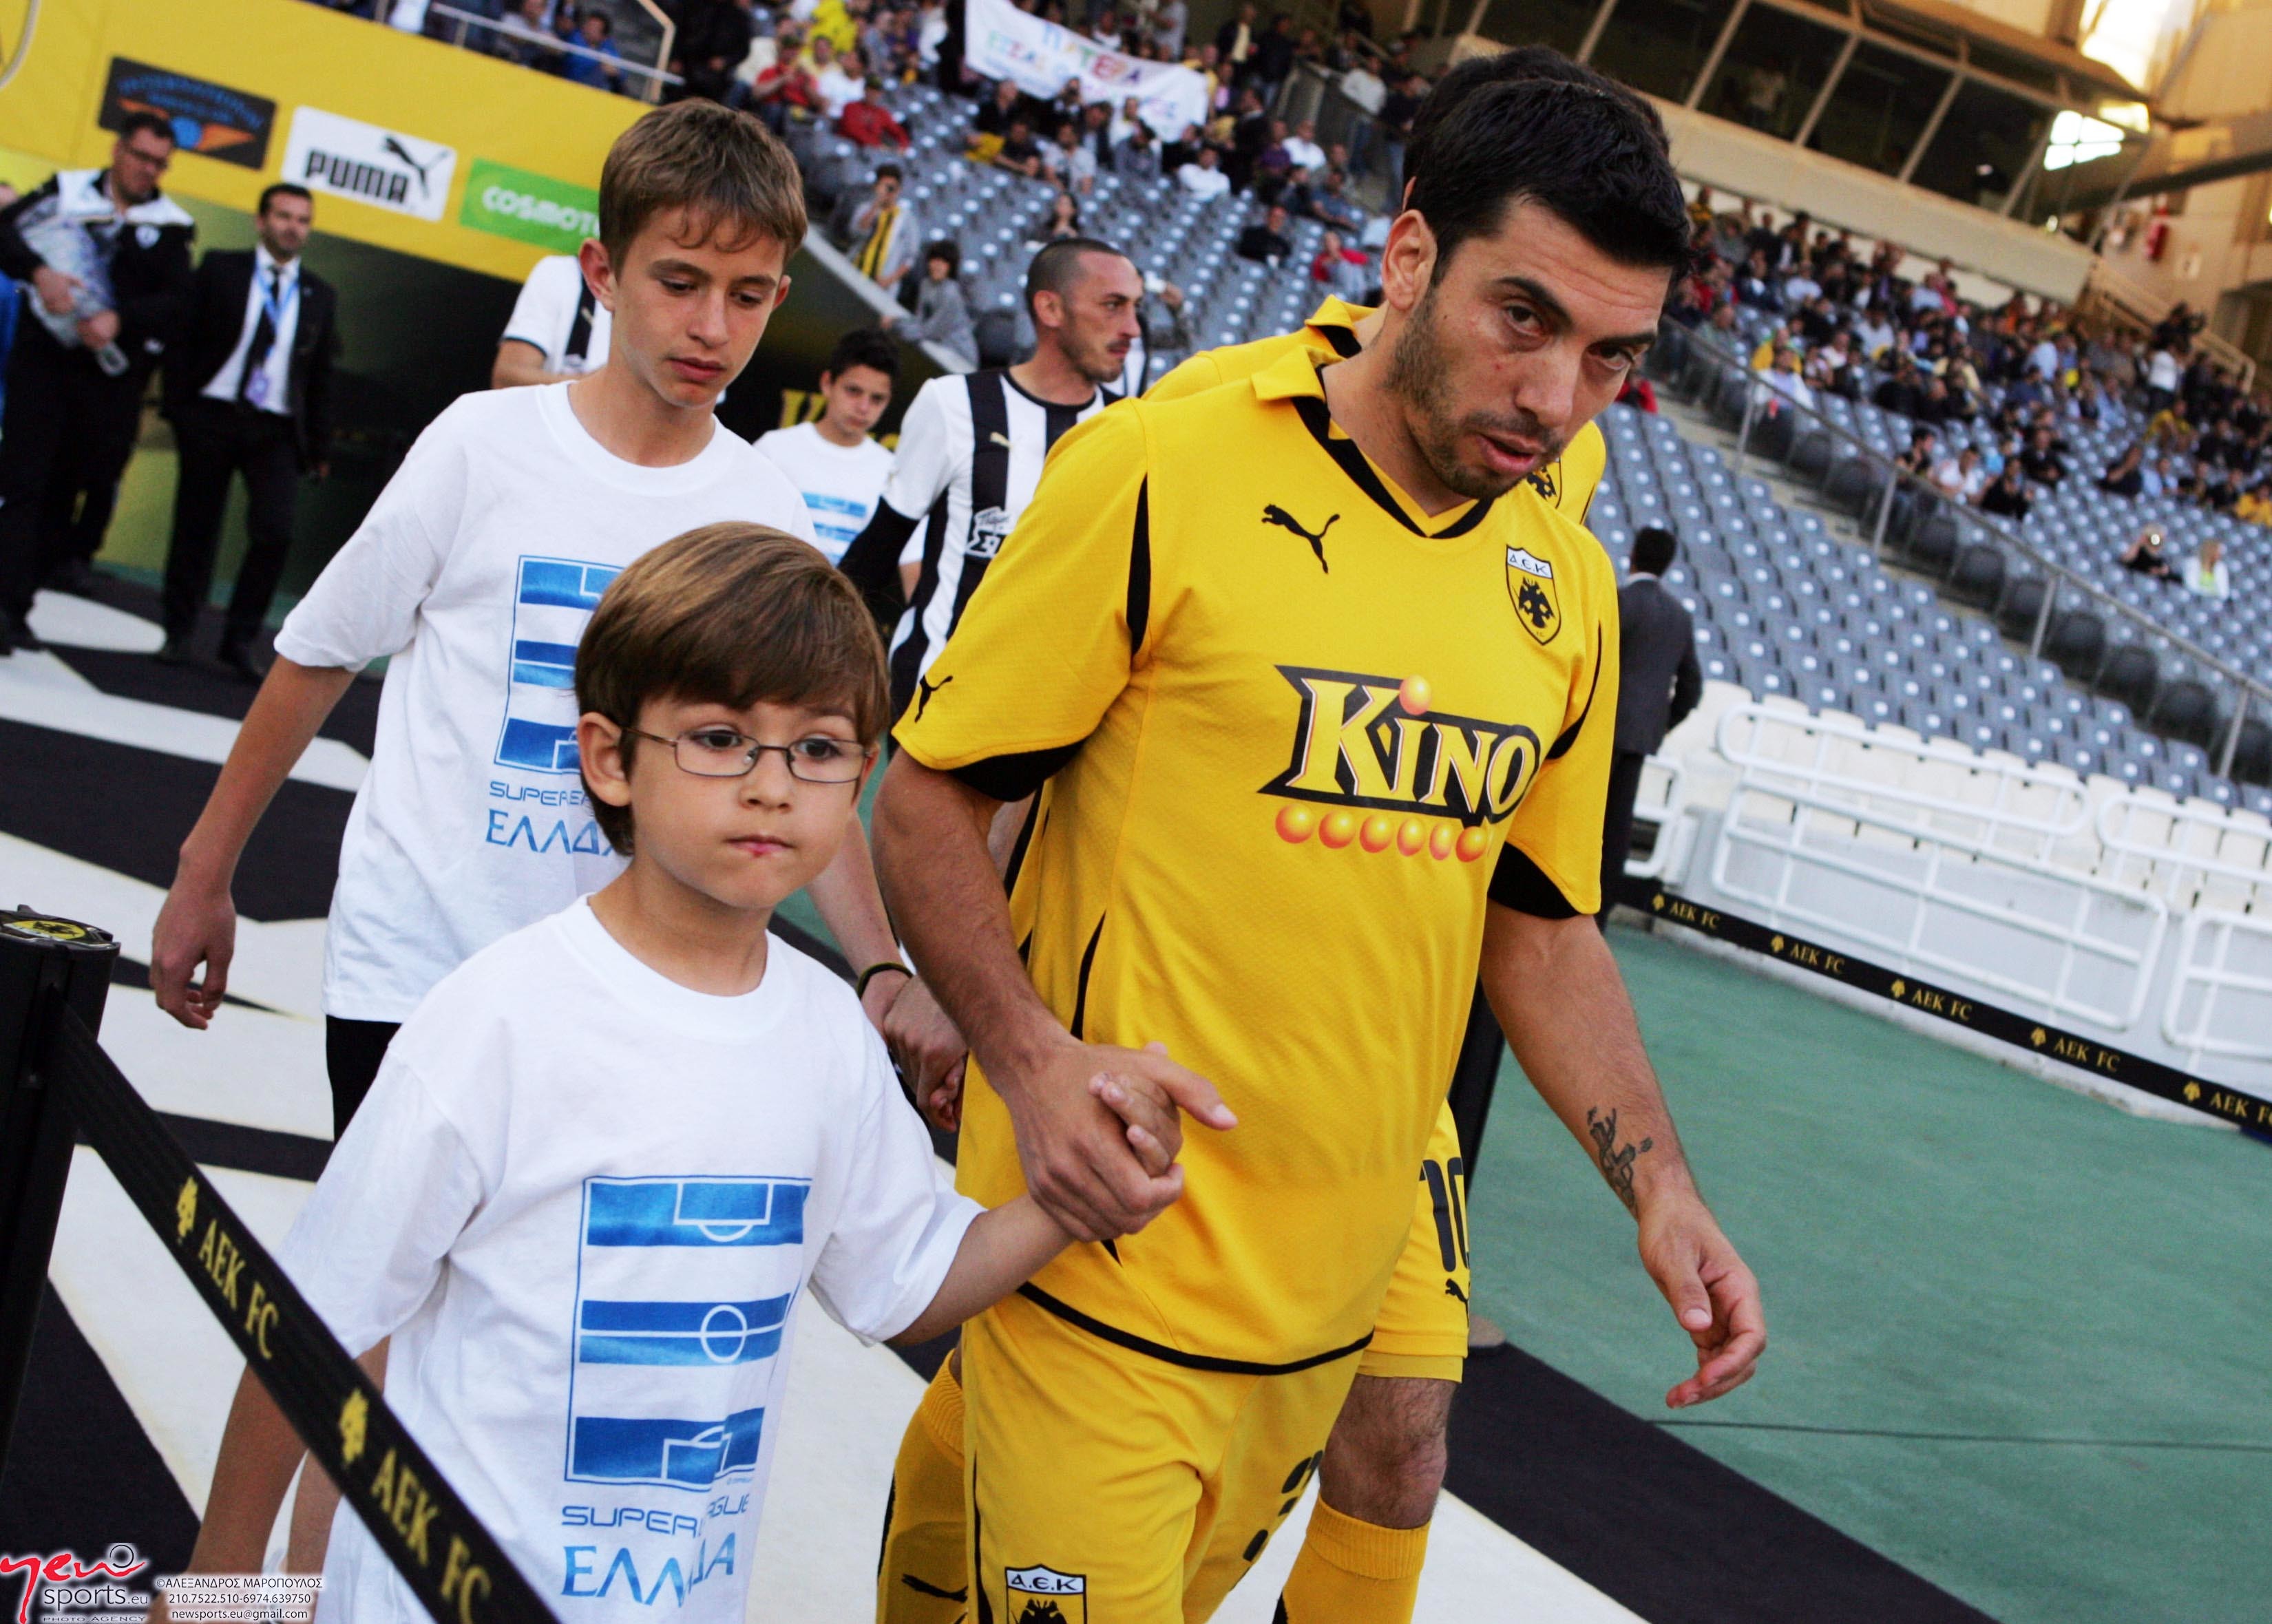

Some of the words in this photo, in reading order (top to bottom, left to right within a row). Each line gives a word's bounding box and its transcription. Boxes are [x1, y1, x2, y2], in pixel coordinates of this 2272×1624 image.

[304, 149, 410, 204] PUMA
[1285, 677, 1537, 816] KINO
[1670, 900, 1696, 921] AEK
[1701, 912, 1721, 930] FC
[1790, 943, 1819, 965] AEK
[1825, 954, 1846, 975] FC
[1911, 988, 1945, 1012] AEK
[1950, 1000, 1973, 1022] FC
[2053, 1037, 2091, 1062] AEK
[2097, 1050, 2121, 1073] FC
[2209, 1091, 2249, 1118] AEK
[198, 1219, 246, 1311] AEK
[243, 1281, 280, 1360] FC
[370, 1448, 441, 1568] AEK
[441, 1534, 492, 1624] FC
